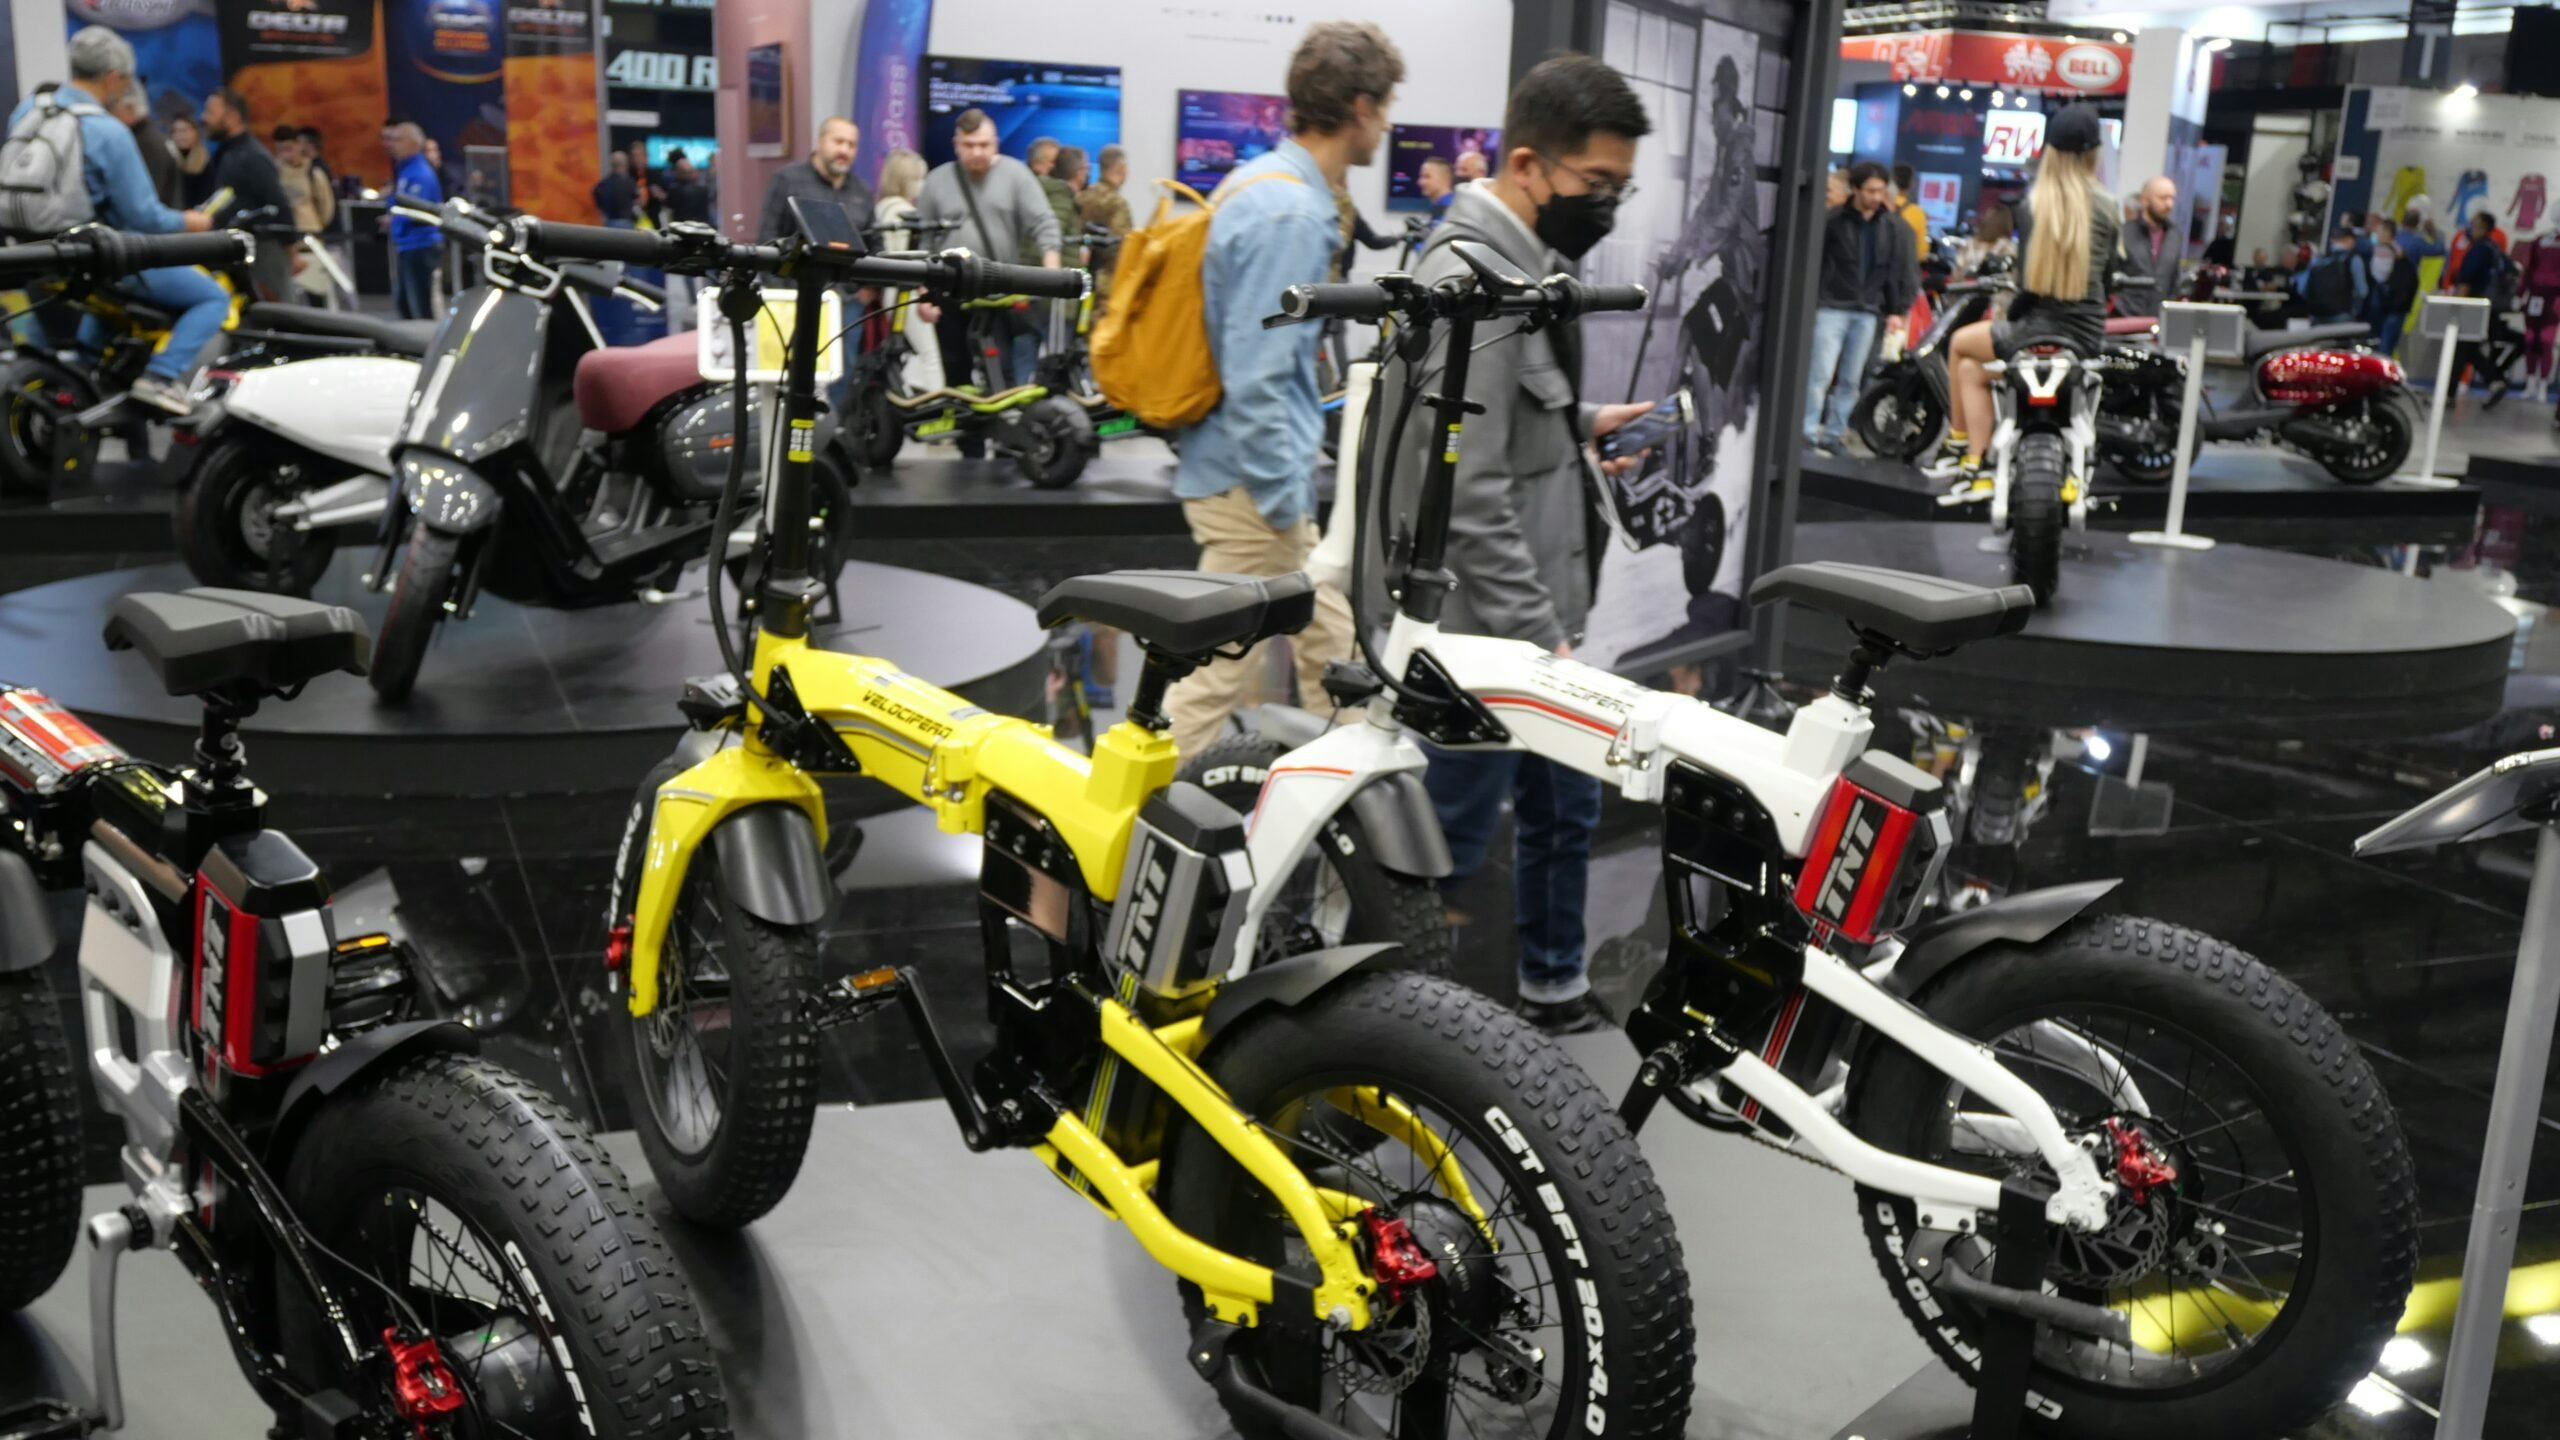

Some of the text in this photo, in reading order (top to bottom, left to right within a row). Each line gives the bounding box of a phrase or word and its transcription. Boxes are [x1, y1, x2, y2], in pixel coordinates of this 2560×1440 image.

[606, 49, 687, 87] 400
[2069, 57, 2109, 77] BELL
[862, 689, 954, 741] VELOCIFERO
[1202, 765, 1240, 788] CST
[1814, 797, 1875, 921] TNT
[1117, 837, 1167, 972] TNT
[1484, 1105, 1609, 1437] CST BFT 20X4.0
[504, 1240, 598, 1438] CST BFT
[2024, 1389, 2064, 1421] CS
